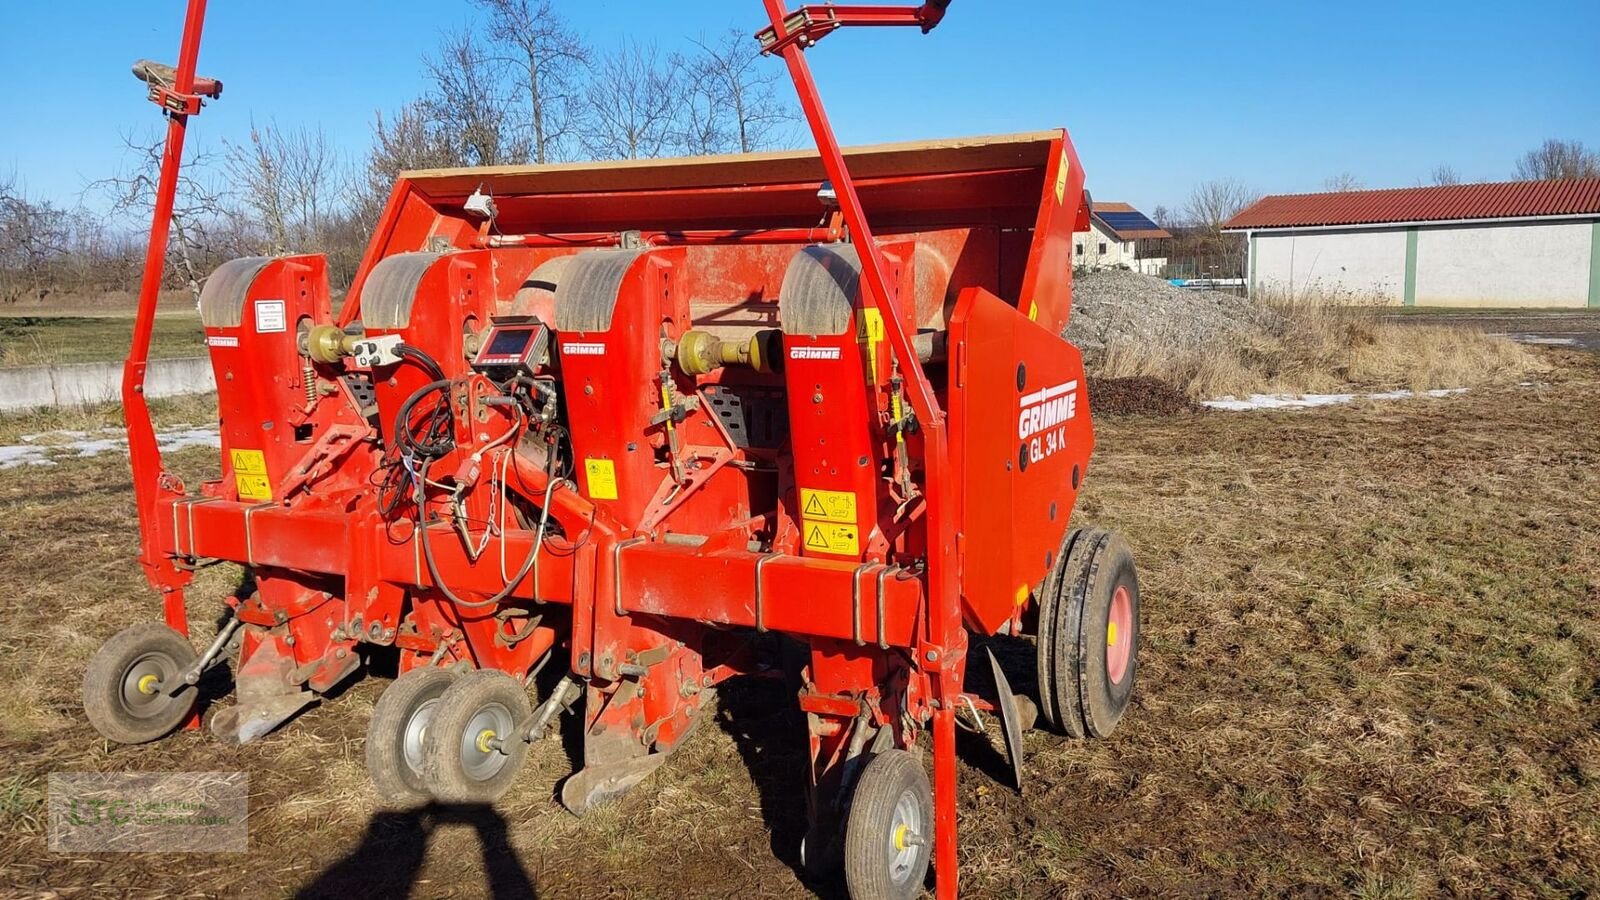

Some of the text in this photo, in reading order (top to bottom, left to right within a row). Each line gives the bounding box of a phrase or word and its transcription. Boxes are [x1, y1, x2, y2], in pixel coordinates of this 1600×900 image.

[563, 343, 606, 355] GRIMME
[790, 346, 841, 360] GRIMME
[1018, 387, 1077, 440] GRIMME
[1030, 425, 1066, 464] GL 34 K
